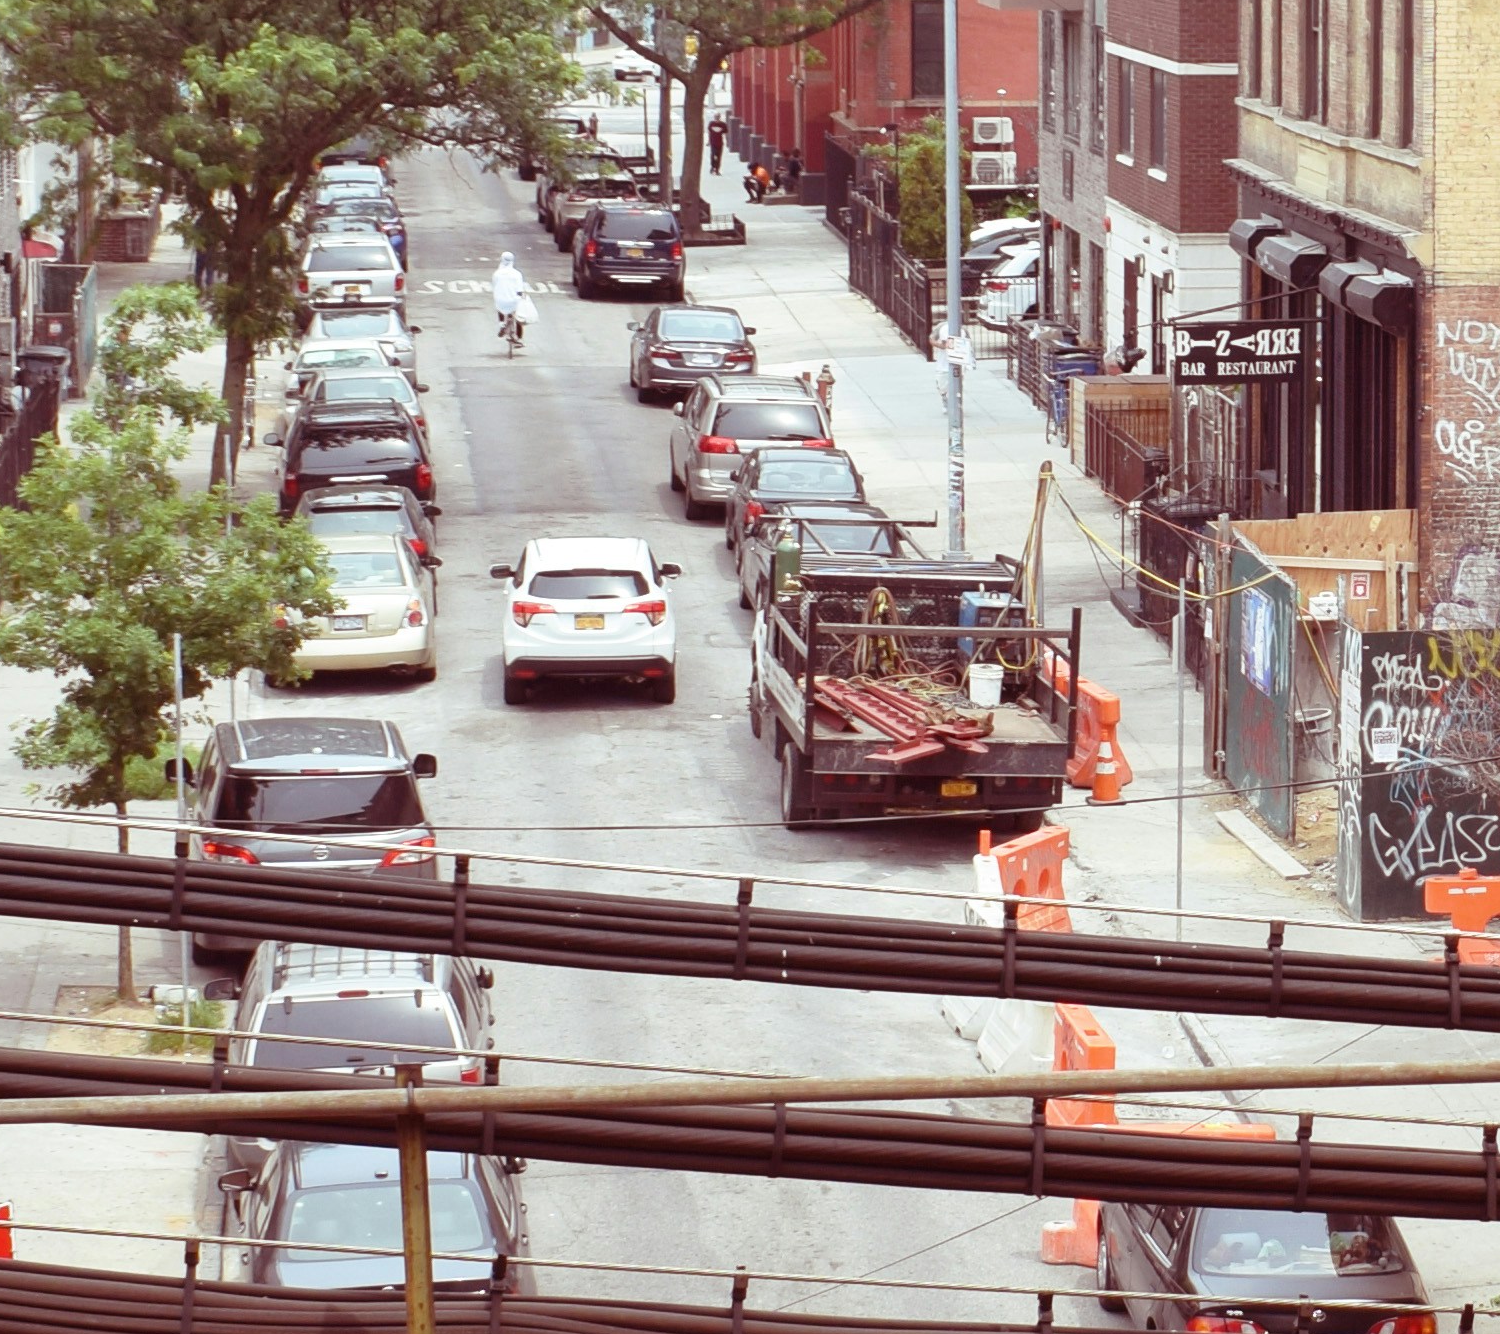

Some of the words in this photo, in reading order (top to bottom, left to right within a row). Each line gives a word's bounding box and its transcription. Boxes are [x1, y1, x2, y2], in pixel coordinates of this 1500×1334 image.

[416, 280, 568, 294] SCHL
[1181, 361, 1206, 376] BAR
[1217, 359, 1297, 376] RESTAURANT
